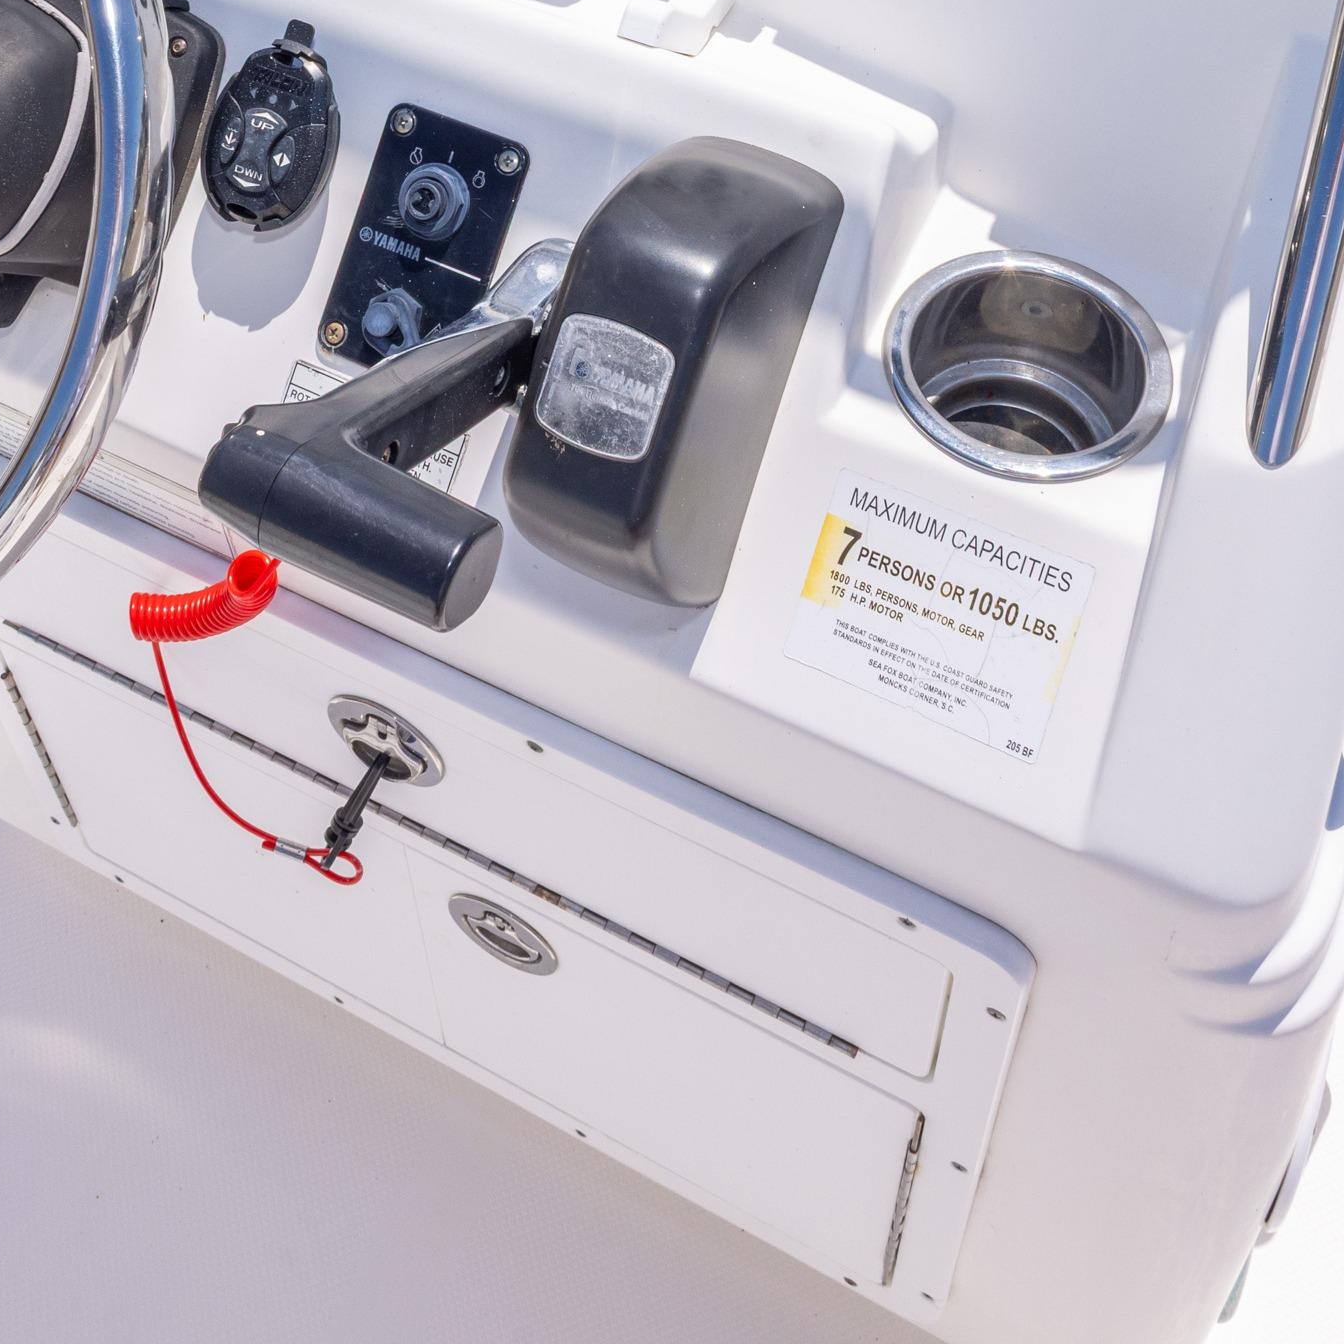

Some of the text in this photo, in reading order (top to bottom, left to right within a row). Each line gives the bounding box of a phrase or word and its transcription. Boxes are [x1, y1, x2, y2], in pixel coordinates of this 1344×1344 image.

[250, 118, 275, 131] UP
[234, 164, 263, 181] DWN
[372, 230, 421, 262] YAMAHA
[849, 487, 1073, 592] MAXIMUM CAPACITIES
[837, 526, 1058, 644] 7 PERSONS OR 1050 LBS.
[830, 570, 851, 585] 1800
[875, 588, 920, 615] PERSONS,
[921, 607, 956, 631] MOTOR,
[958, 623, 985, 641] GEAR
[831, 585, 904, 623] 175 H.P. MOTOR
[833, 628, 872, 650] STANDARDS
[872, 645, 879, 654] IN
[880, 648, 906, 664] EFFECT
[906, 660, 917, 669] ON
[931, 670, 948, 683] DATE
[949, 678, 959, 688] OF
[960, 683, 1011, 710] CERTIFICATION
[836, 619, 850, 630] THIS
[850, 625, 867, 636] BOAT
[868, 633, 899, 651] COMPLIES
[900, 646, 916, 657] WITH
[917, 654, 929, 664] THE
[943, 664, 965, 678] COAST
[965, 674, 988, 689] GUARD
[989, 685, 1013, 700] SAFETY
[868, 658, 882, 670] SEA
[883, 664, 897, 677] FOX
[897, 671, 917, 683] BOAT
[878, 674, 908, 693] MONCKS
[1006, 739, 1034, 757] 205 BF
